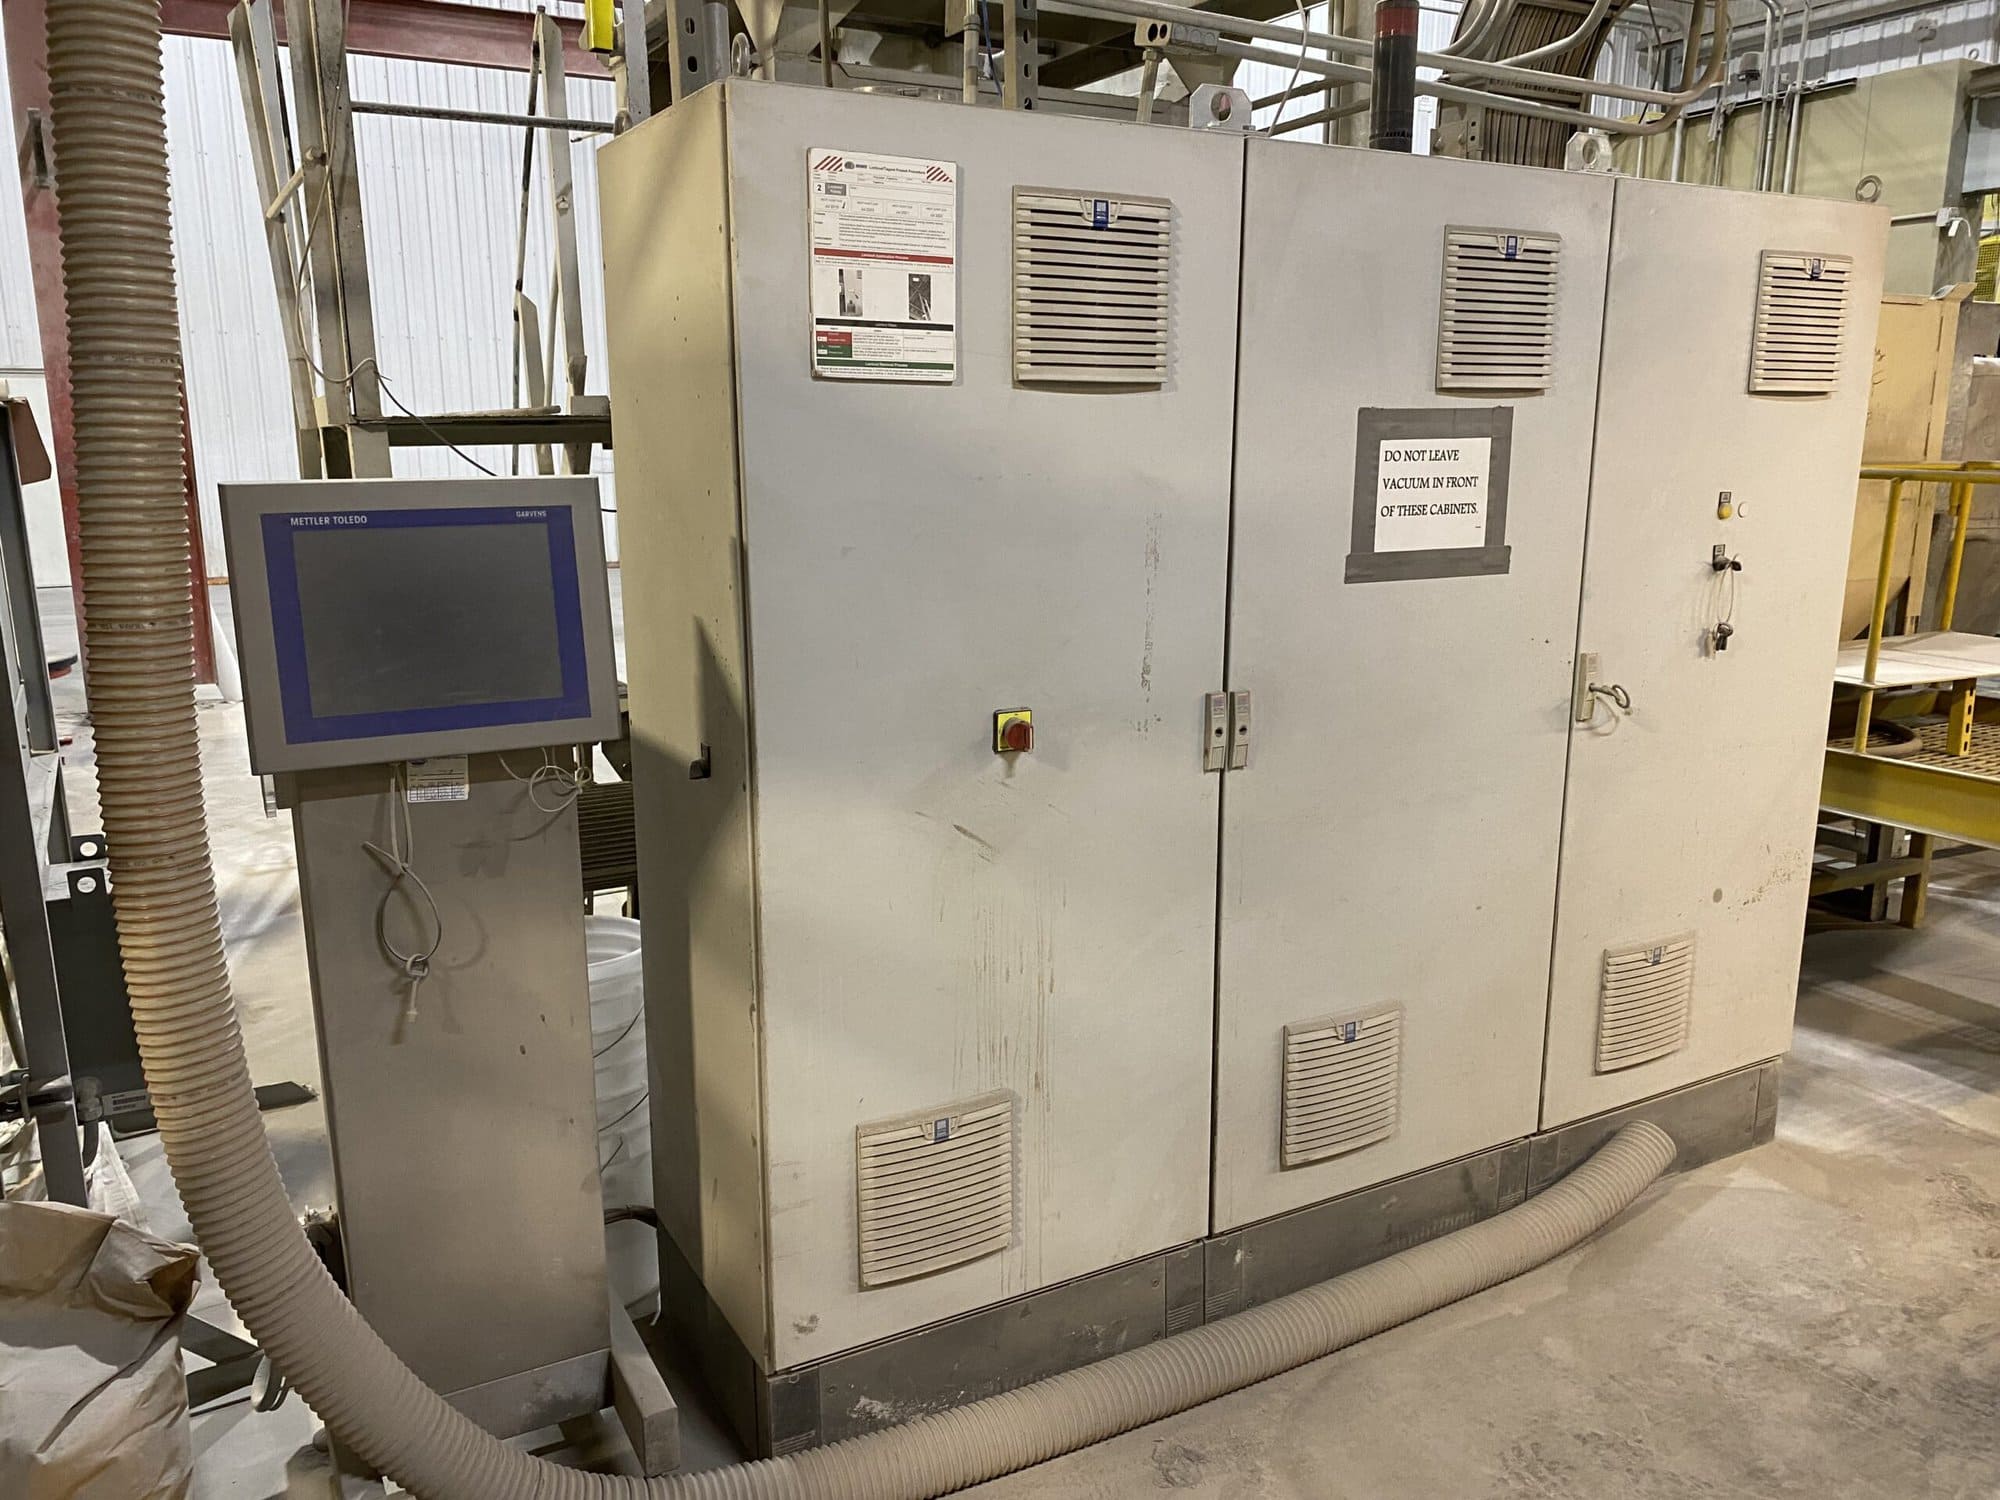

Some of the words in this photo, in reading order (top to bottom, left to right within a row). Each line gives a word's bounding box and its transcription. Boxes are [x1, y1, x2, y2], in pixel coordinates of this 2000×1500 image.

[1384, 450, 1401, 462] DO
[1404, 450, 1427, 462] NOT
[1429, 449, 1460, 461] LEAVE
[1382, 477, 1430, 489] VACUUM
[1432, 476, 1444, 488] IN
[1446, 476, 1479, 488] FRONT
[1380, 505, 1395, 517] OF
[1397, 504, 1428, 516] THESE
[1429, 502, 1479, 515] CABINETS.
[290, 516, 330, 526] METTLER
[333, 515, 368, 525] TOLEDO
